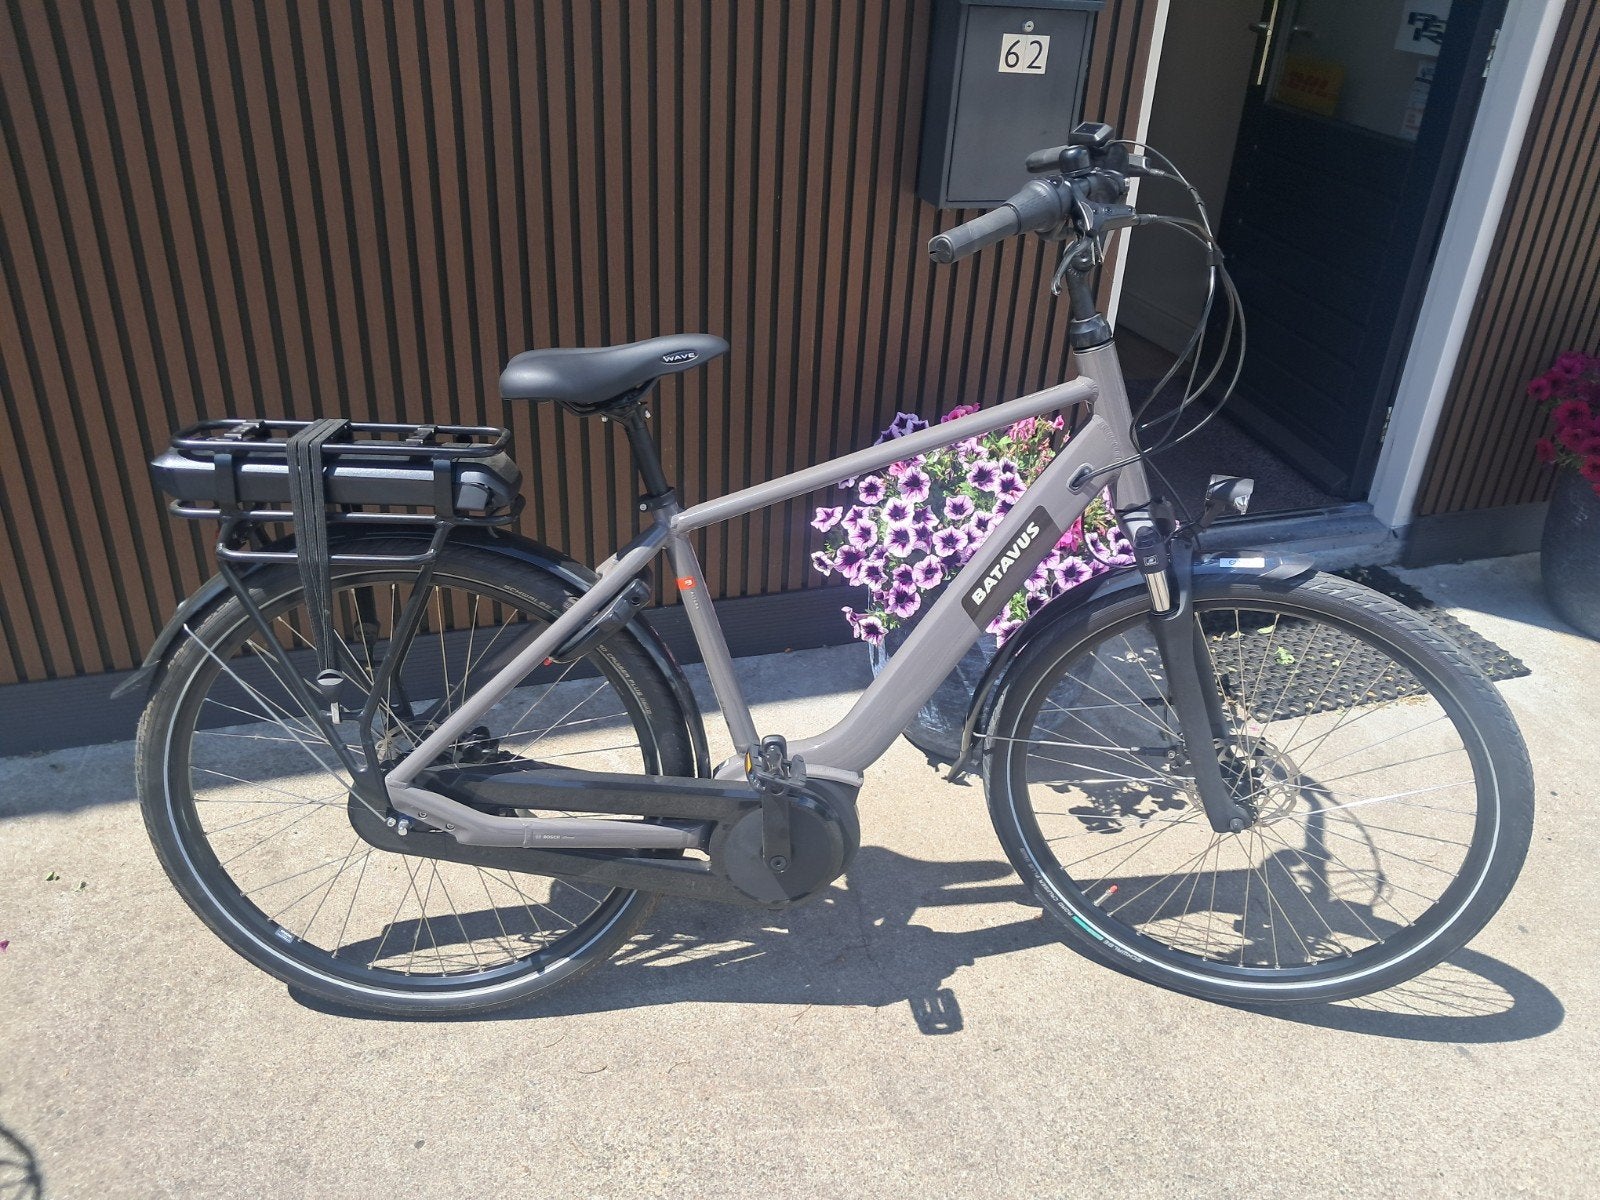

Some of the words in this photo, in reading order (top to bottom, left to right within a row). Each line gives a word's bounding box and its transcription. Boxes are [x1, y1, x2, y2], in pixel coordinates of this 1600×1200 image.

[1004, 39, 1043, 70] 62
[662, 352, 696, 363] WAVE
[971, 521, 1040, 606] BATAVUS
[503, 584, 552, 610] SCHWALBE
[606, 652, 631, 678] CRUISER
[629, 679, 644, 696] PLUS
[1038, 879, 1059, 902] CRUISER
[1057, 901, 1074, 916] ROAD
[1103, 939, 1144, 963] SCHWALBE
